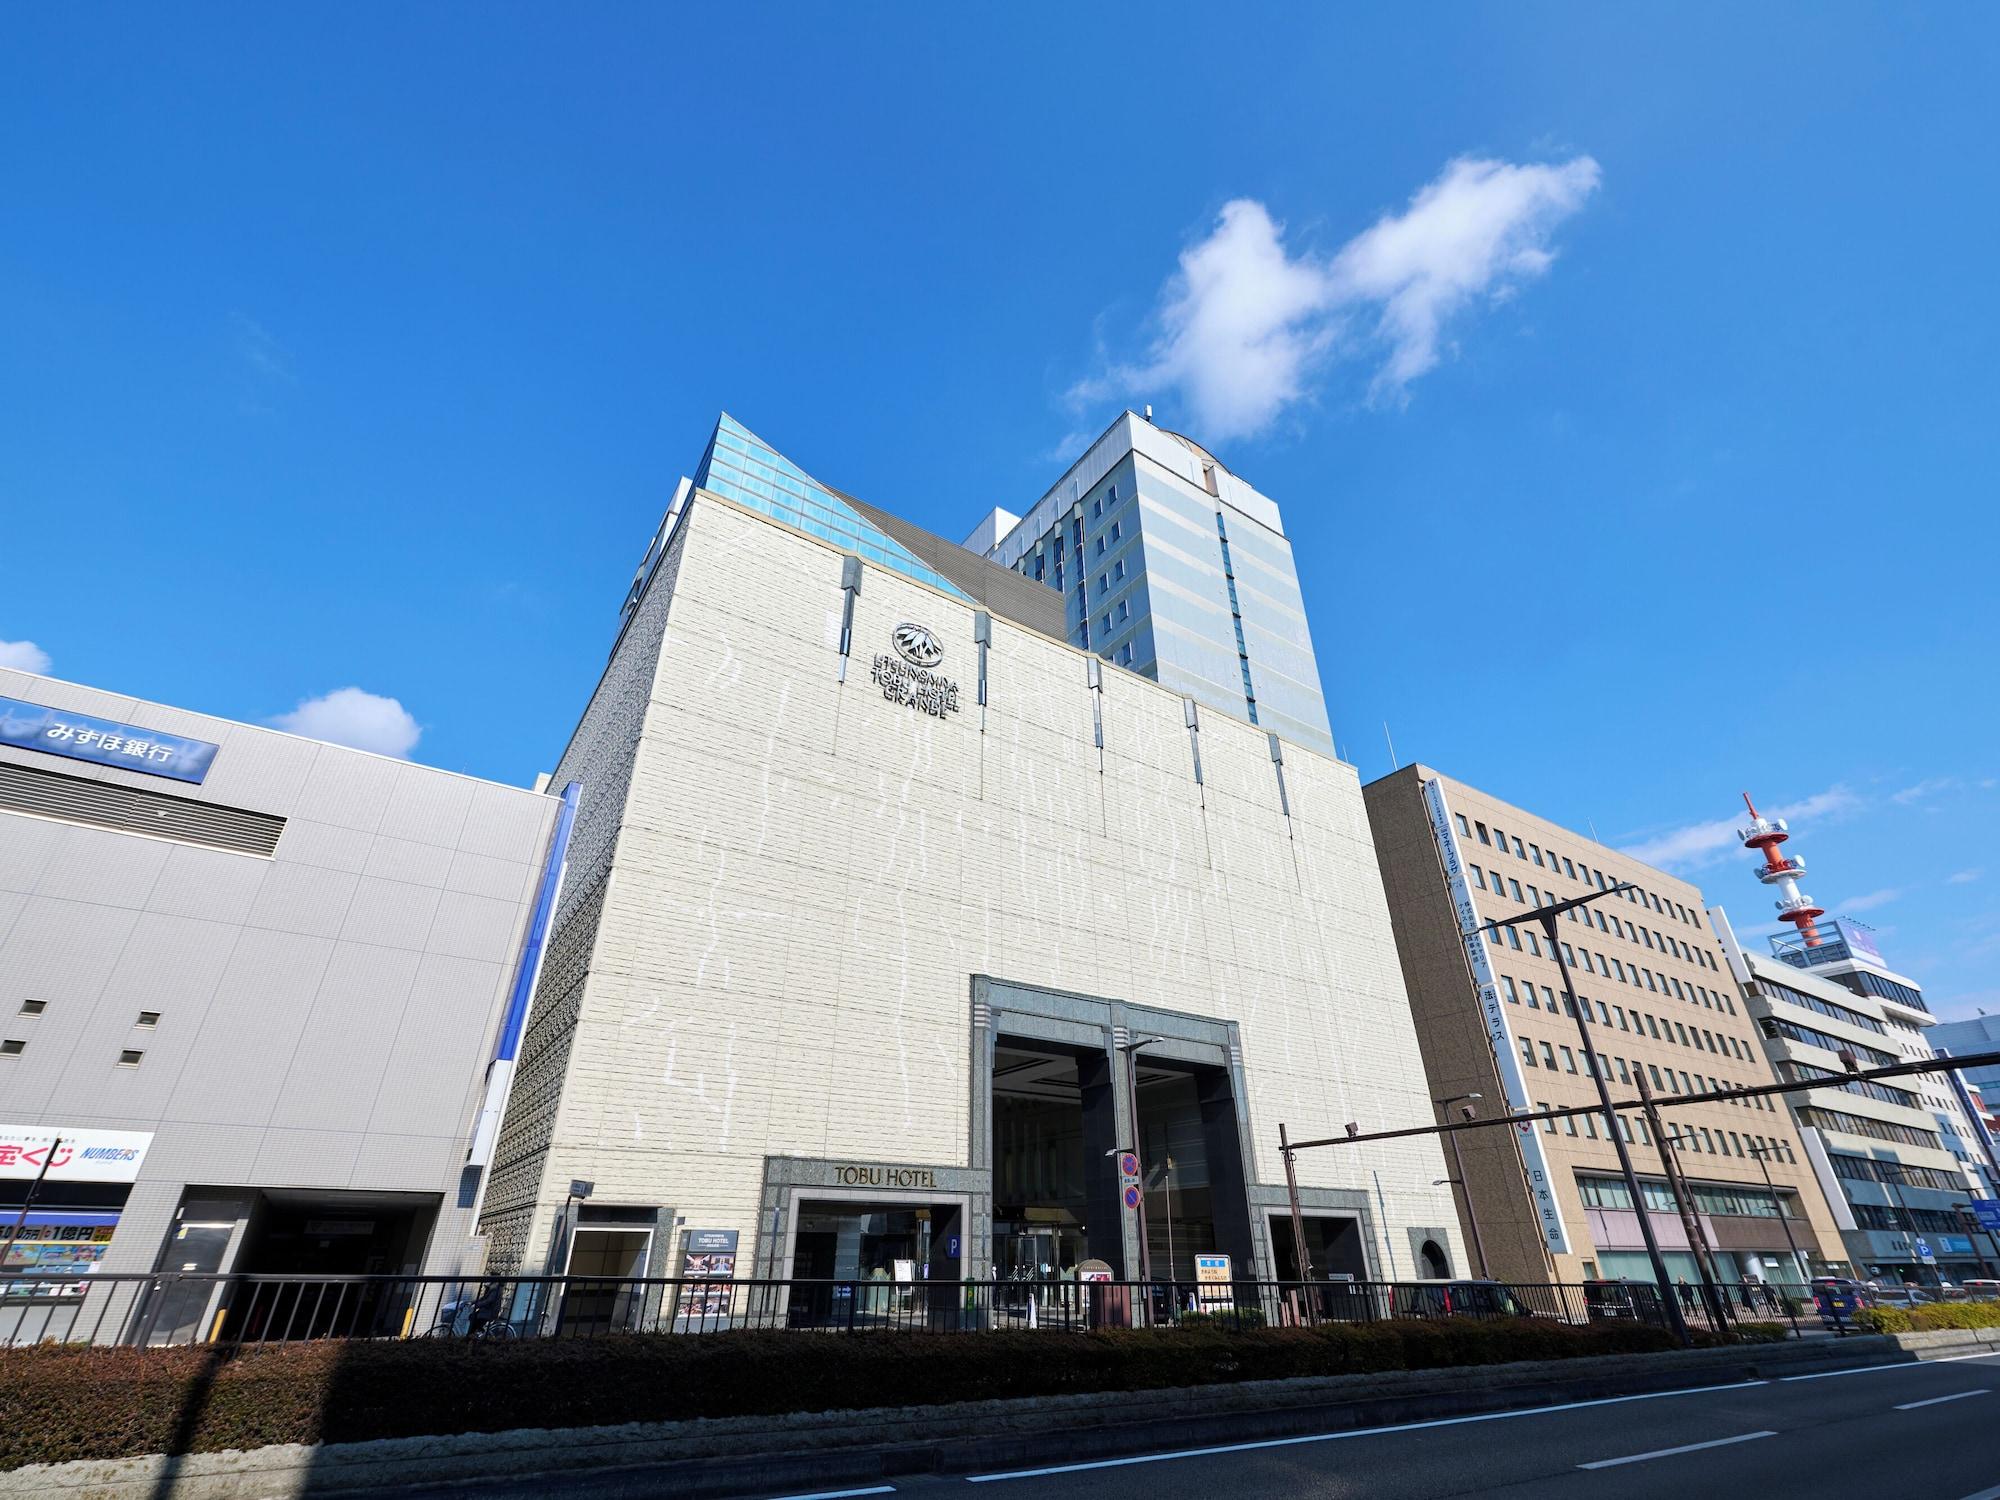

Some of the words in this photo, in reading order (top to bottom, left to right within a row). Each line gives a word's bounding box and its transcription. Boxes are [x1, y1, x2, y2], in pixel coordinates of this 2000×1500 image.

[883, 684, 947, 720] GRANDE
[47, 722, 173, 763] みずほ銀行
[1484, 989, 1505, 1041] 法テラス
[80, 1147, 140, 1161] NUMBERS
[835, 1166, 881, 1185] TOBU
[886, 1168, 937, 1188] HOTEL
[1533, 1170, 1560, 1240] 日本生命
[951, 1238, 958, 1254] P
[1921, 1246, 1929, 1254] P
